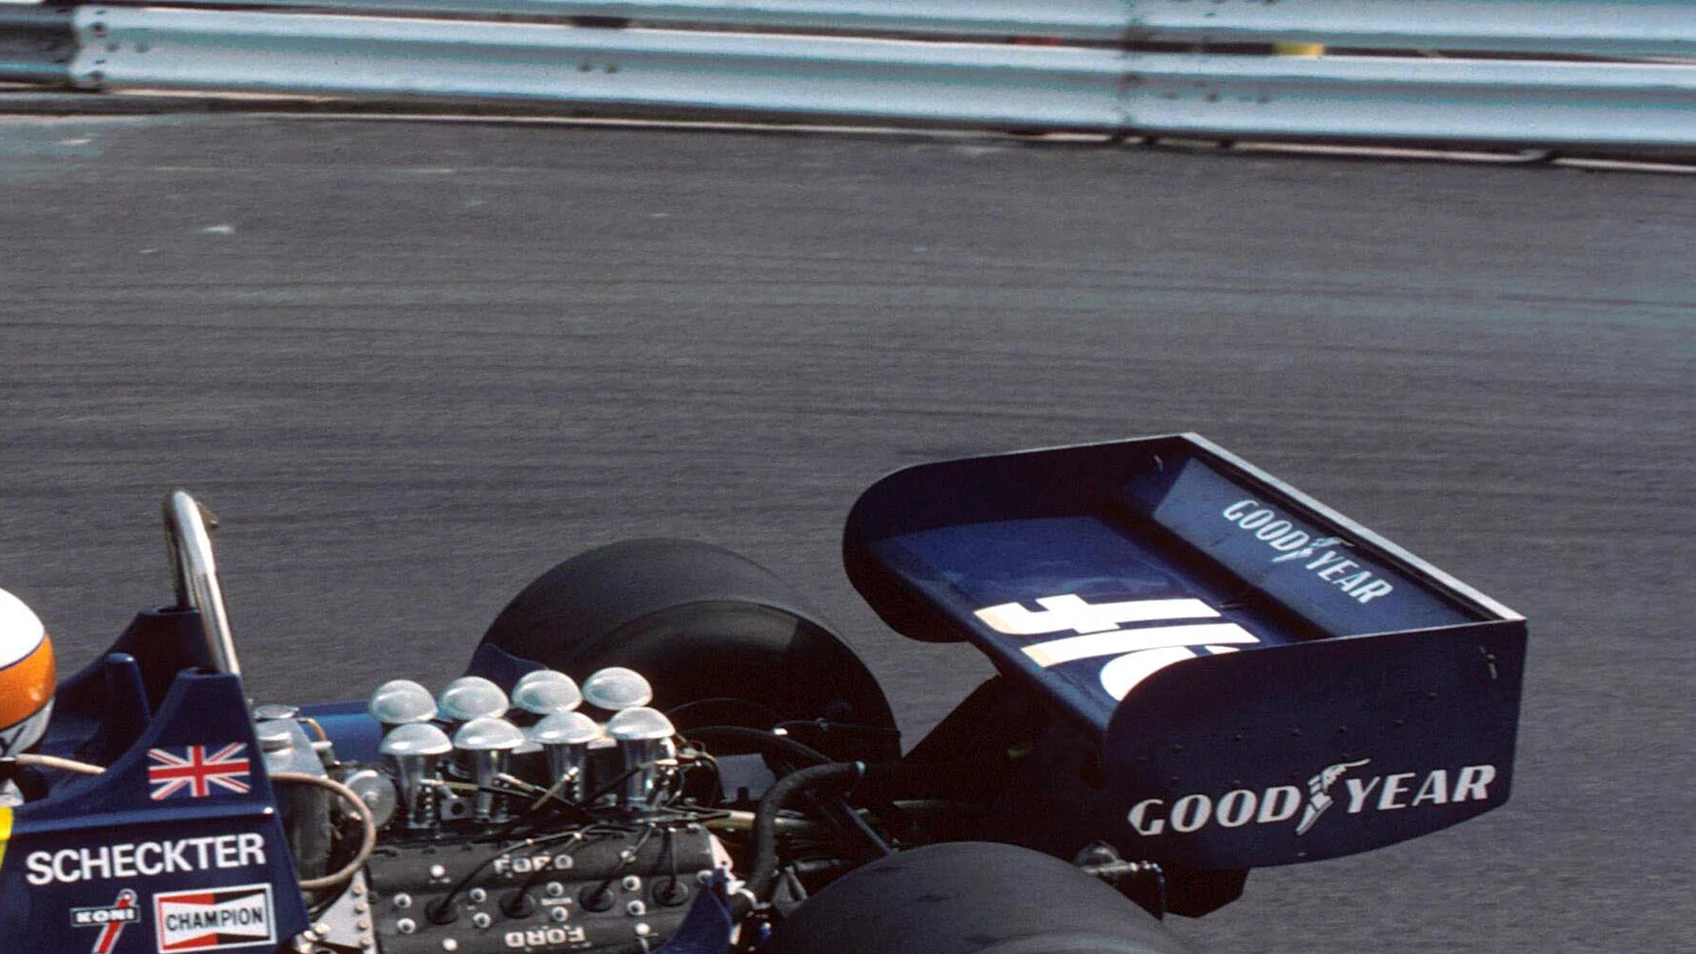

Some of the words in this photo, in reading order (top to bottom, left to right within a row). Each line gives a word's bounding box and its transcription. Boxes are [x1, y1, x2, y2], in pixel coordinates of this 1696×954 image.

[25, 832, 267, 885] SCHECKTER
[75, 907, 135, 924] KONI
[166, 907, 264, 932] CHAMPION
[505, 926, 586, 948] FORD
